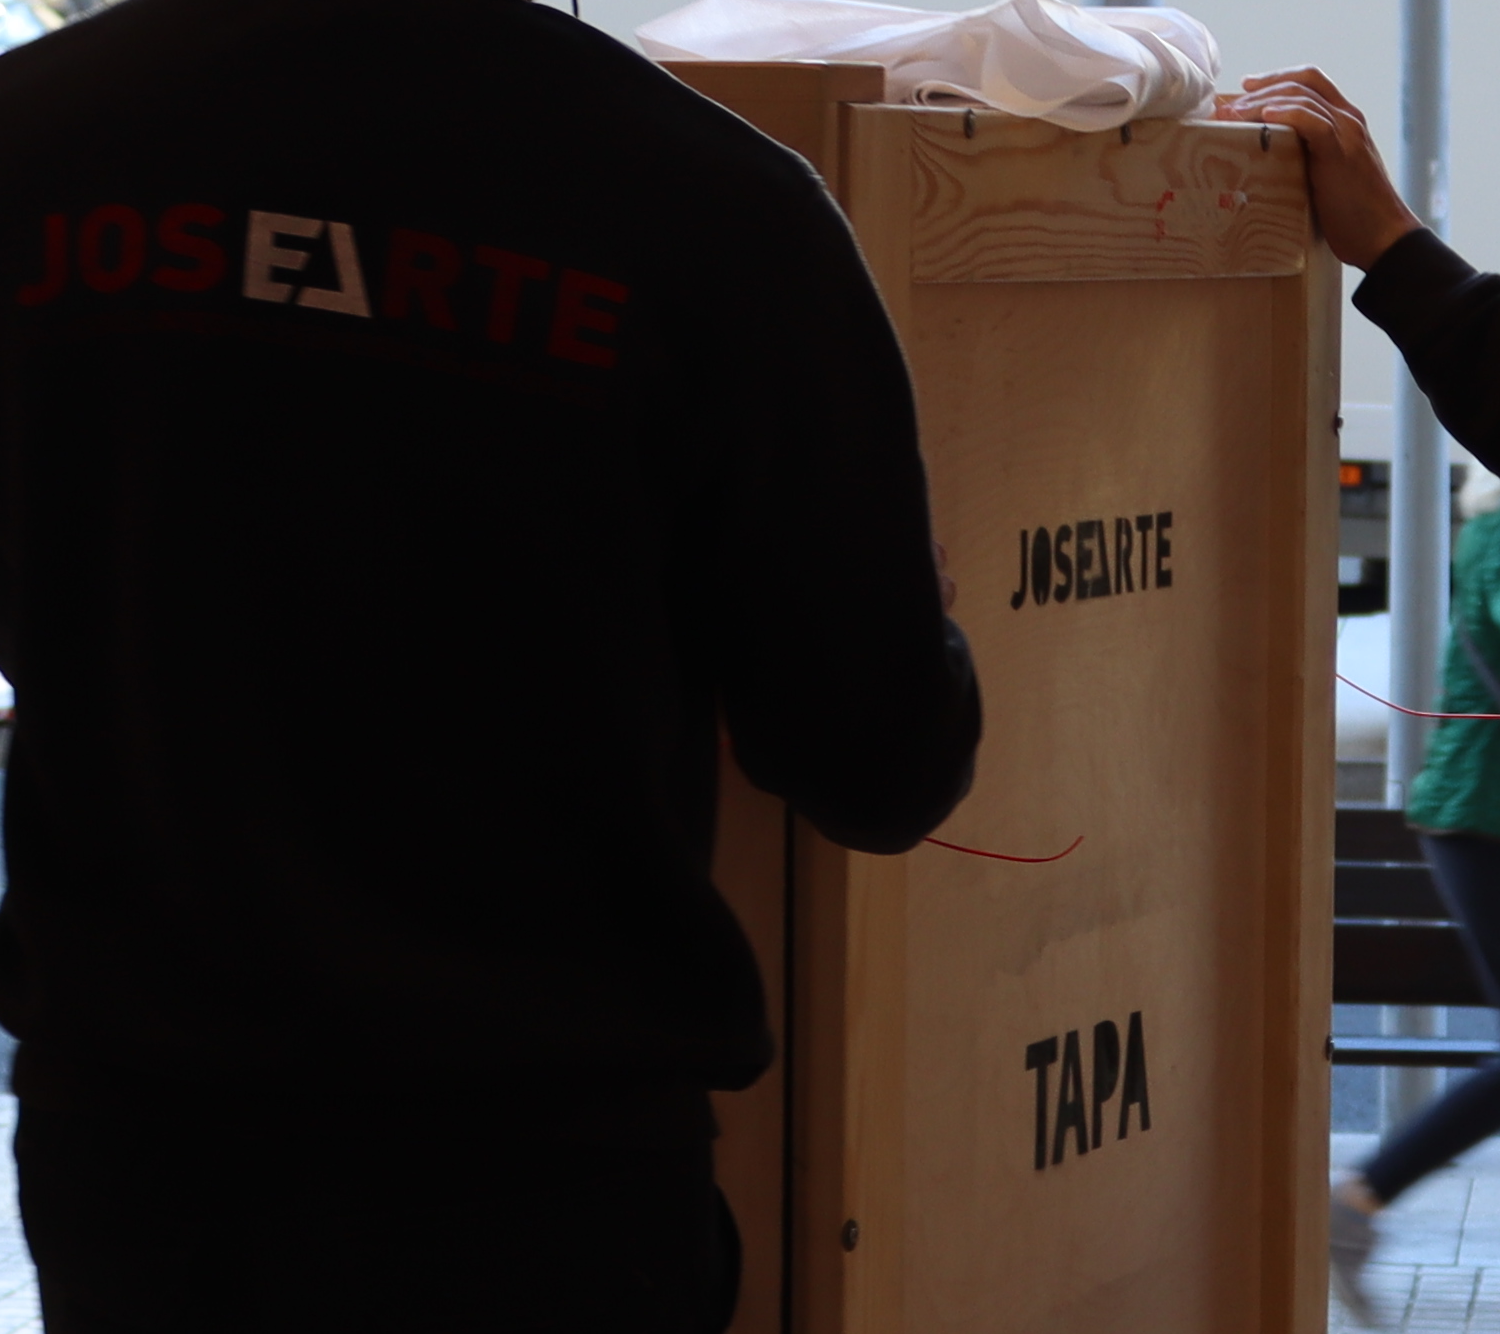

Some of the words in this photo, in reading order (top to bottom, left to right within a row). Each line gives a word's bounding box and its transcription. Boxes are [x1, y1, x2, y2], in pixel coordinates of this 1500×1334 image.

[15, 203, 632, 370] JOSEARTE
[1010, 511, 1172, 610] JOSEARTE
[1025, 1010, 1151, 1171] TAPA
